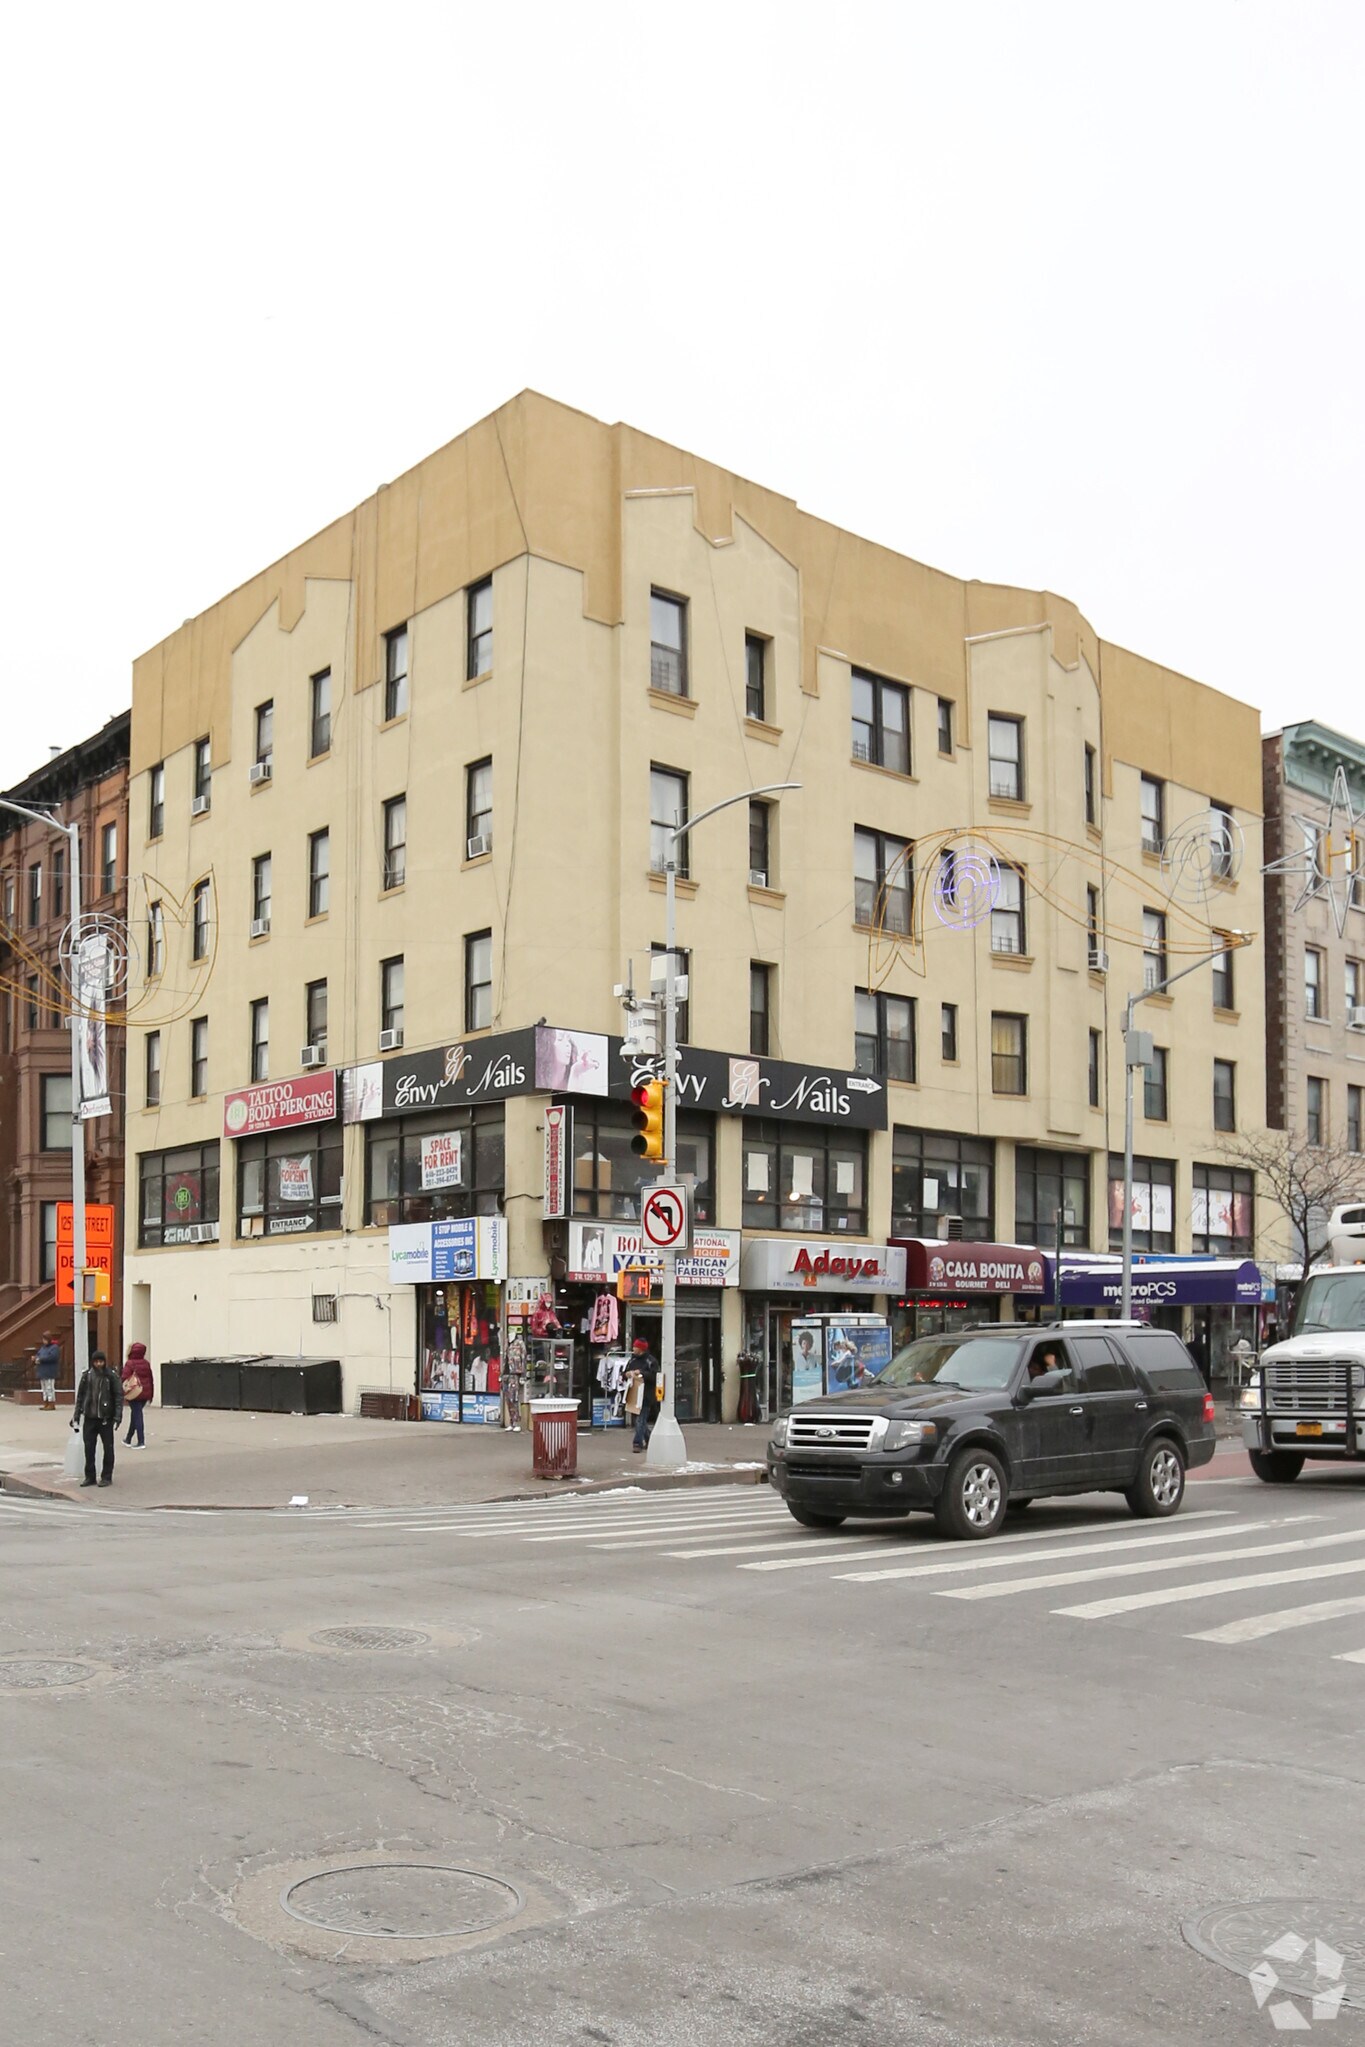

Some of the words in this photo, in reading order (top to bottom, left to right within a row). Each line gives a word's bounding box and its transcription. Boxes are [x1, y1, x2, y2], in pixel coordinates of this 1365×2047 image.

[395, 1075, 440, 1106] Envy
[466, 1054, 526, 1096] Nails
[848, 1080, 875, 1090] ENTRANCE
[248, 1083, 293, 1107] TATTOO
[770, 1076, 851, 1115] Nails
[248, 1101, 279, 1123] BODY
[279, 1090, 333, 1117] PIERCING
[304, 1107, 333, 1119] STUDIO
[430, 1137, 451, 1153] SPACE
[424, 1154, 438, 1169] FOR
[440, 1150, 458, 1167] RENT
[85, 1217, 109, 1232] TREET
[271, 1217, 306, 1229] ENTRANCE
[693, 1238, 727, 1247] ATIONAL
[391, 1247, 429, 1262] Lycamobile
[694, 1248, 722, 1257] TIQUE
[61, 1255, 108, 1268] DEOUR
[677, 1258, 727, 1267] AFRICAN
[792, 1247, 879, 1280] Adaya
[677, 1267, 725, 1277] FABRICS
[945, 1261, 978, 1278] CASA
[979, 1262, 1025, 1280] BONITA
[955, 1280, 988, 1289] GOURMET
[994, 1280, 1011, 1289] DELI
[1103, 1281, 1176, 1297] meroPCS
